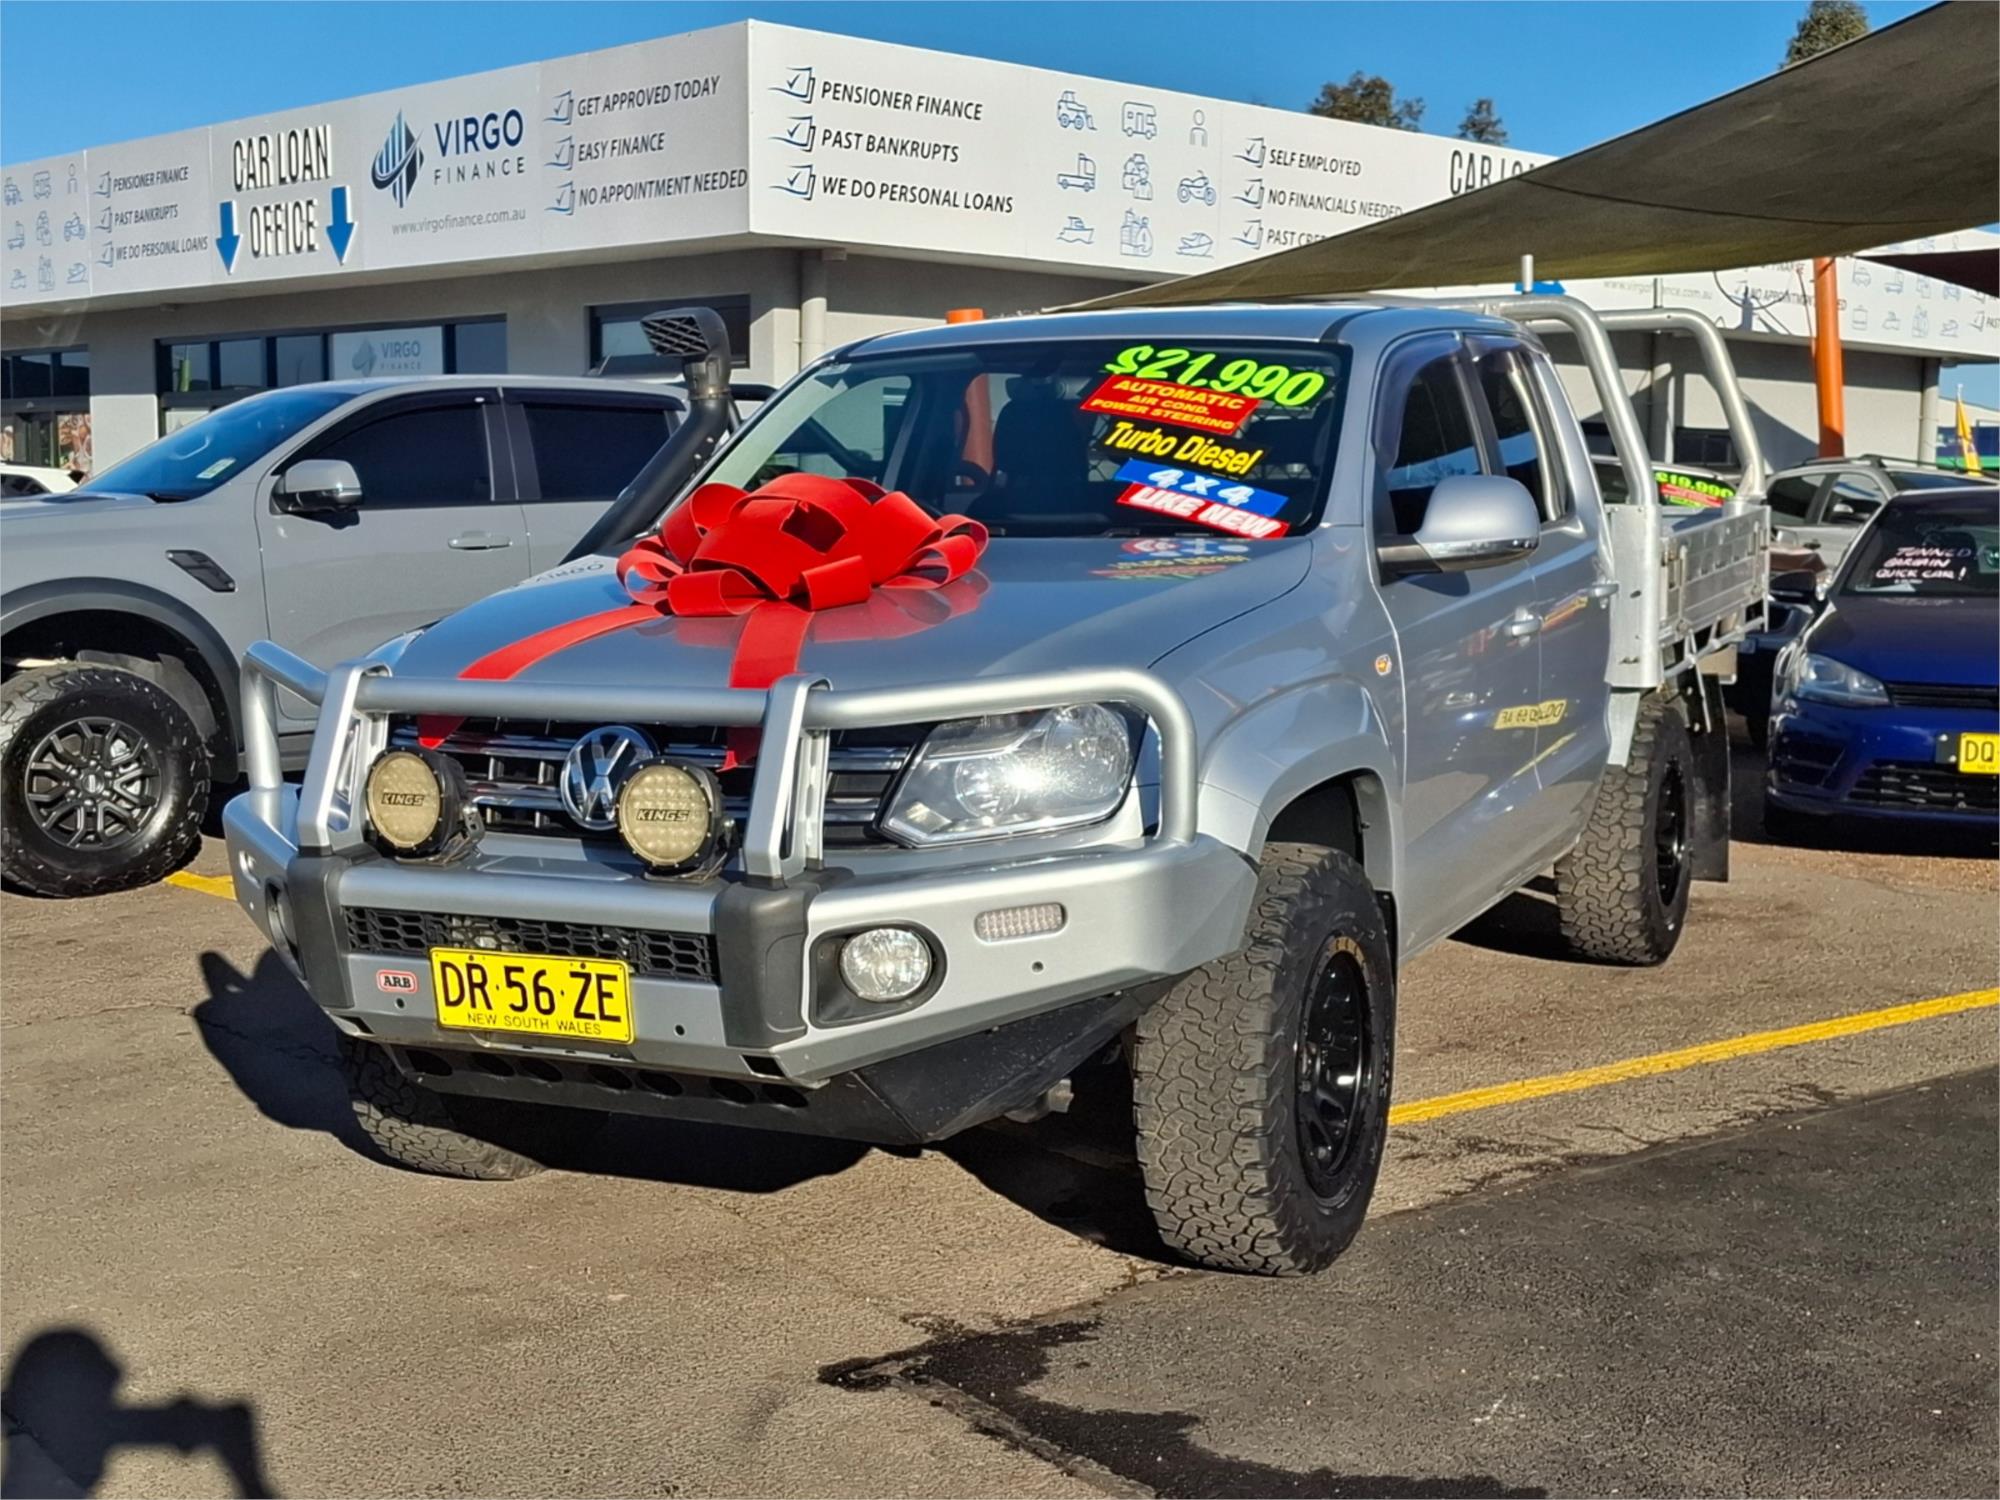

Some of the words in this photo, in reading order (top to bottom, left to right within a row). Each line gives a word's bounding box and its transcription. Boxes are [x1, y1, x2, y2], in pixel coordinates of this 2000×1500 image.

[577, 96, 602, 117] GET
[602, 85, 671, 113] APPROVED
[672, 75, 721, 103] TODAY
[821, 80, 912, 112] PENSIONER
[916, 95, 983, 121] FINANCE
[434, 108, 524, 158] VIRGO
[578, 139, 610, 162] EASY
[611, 132, 665, 158] FINANCE
[821, 129, 863, 151] PAST
[866, 133, 959, 163] BANKRUPTS
[233, 135, 271, 192] CAR
[277, 125, 331, 186] LOAN
[434, 156, 526, 186] FINANCE
[1269, 148, 1296, 167] SELF
[1298, 153, 1361, 176] EMPLOYED
[1450, 150, 1492, 195] CAR
[113, 172, 155, 191] PENSIONER
[157, 166, 189, 184] FINANCE
[579, 187, 598, 207] NO
[600, 176, 691, 205] APPOINTMENT
[693, 168, 747, 193] NEEDED
[822, 176, 848, 196] WE
[851, 180, 876, 199] DO
[880, 183, 960, 208] PERSONAL
[964, 192, 1014, 213] LOANS
[1268, 189, 1286, 206] NO
[1289, 192, 1356, 215] FINANCIALS
[115, 211, 134, 226] PAST
[134, 204, 178, 224] BANKRUPTS
[250, 199, 317, 258] OFFICE
[392, 209, 526, 234] www.virgofinance.com.au
[116, 246, 128, 260] WE
[129, 244, 140, 259] DO
[141, 240, 180, 257] PERSONAL
[182, 235, 208, 253] LOANS
[1267, 228, 1296, 246] PAST
[381, 340, 422, 359] VIRGO
[1105, 345, 1325, 406] $21.990
[1112, 380, 1247, 410] AUTOMATIC
[1128, 394, 1160, 407] AIR
[1161, 398, 1211, 416] COND.
[1090, 398, 1147, 415] POWER
[1150, 408, 1235, 431] STEERING
[1105, 422, 1178, 456] Turbo
[1174, 436, 1264, 474] Diesel
[1128, 487, 1207, 518] LIKE
[1198, 503, 1282, 539] NEW
[1875, 568, 1919, 579] QUICK
[381, 792, 425, 807] KINGS
[636, 808, 690, 823] KINGS
[384, 975, 411, 989] ARB
[467, 1012, 500, 1027] NEW
[503, 1014, 550, 1032] SOUTH
[556, 1018, 602, 1036] WALES
